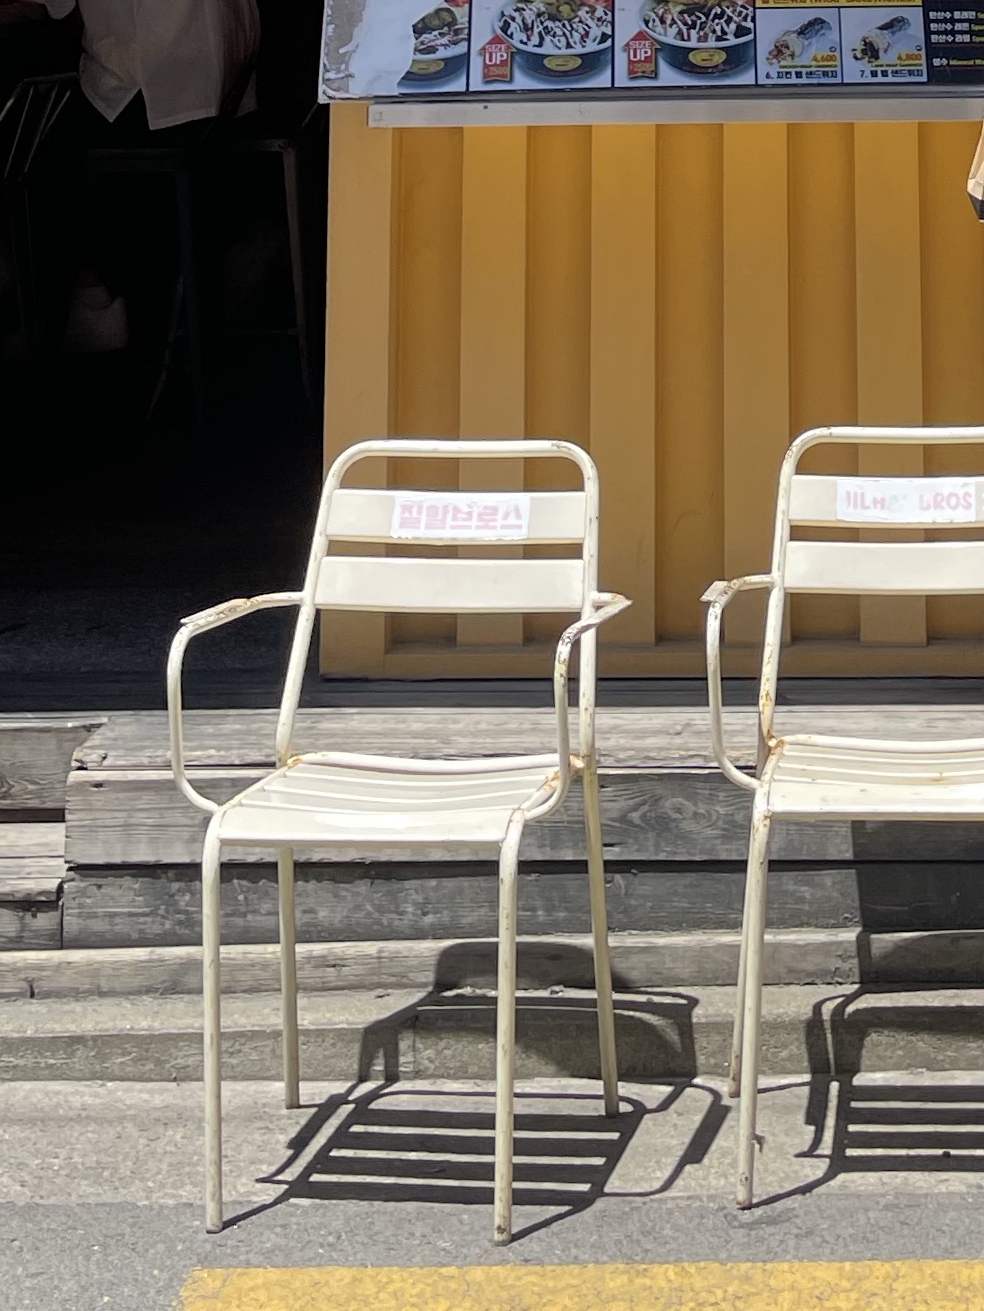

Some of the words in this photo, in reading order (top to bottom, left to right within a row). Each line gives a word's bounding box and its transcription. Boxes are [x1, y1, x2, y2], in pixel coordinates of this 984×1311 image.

[485, 44, 508, 53] SIZE
[629, 41, 652, 49] SIZE
[485, 52, 507, 65] UP
[629, 49, 652, 61] UP
